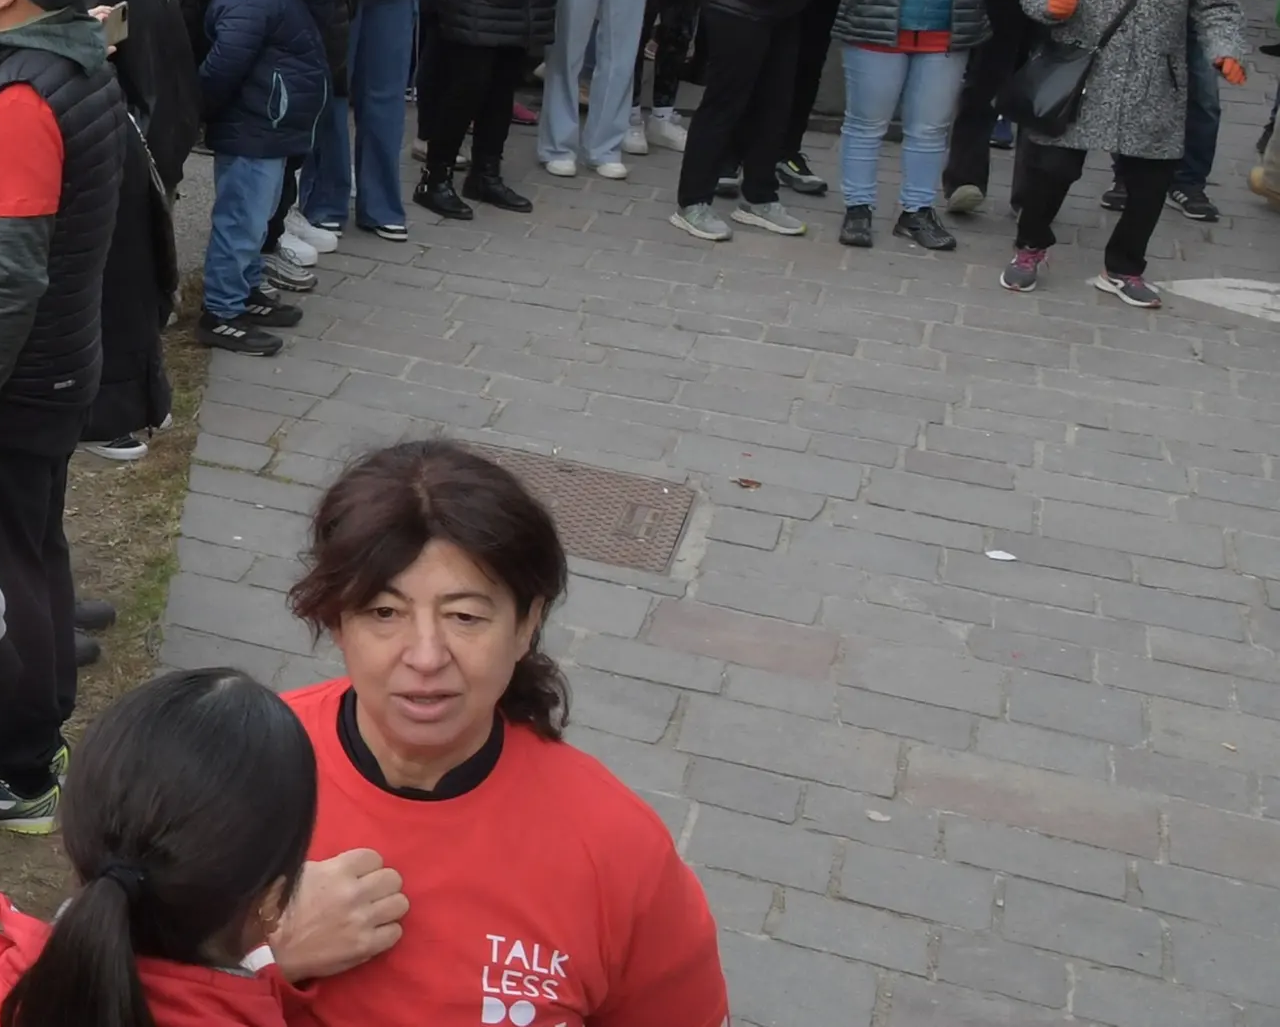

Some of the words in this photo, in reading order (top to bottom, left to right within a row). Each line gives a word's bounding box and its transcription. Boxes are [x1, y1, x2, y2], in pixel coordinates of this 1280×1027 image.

[485, 933, 570, 979] TALK
[482, 965, 559, 1001] LESS
[481, 995, 537, 1027] DO
